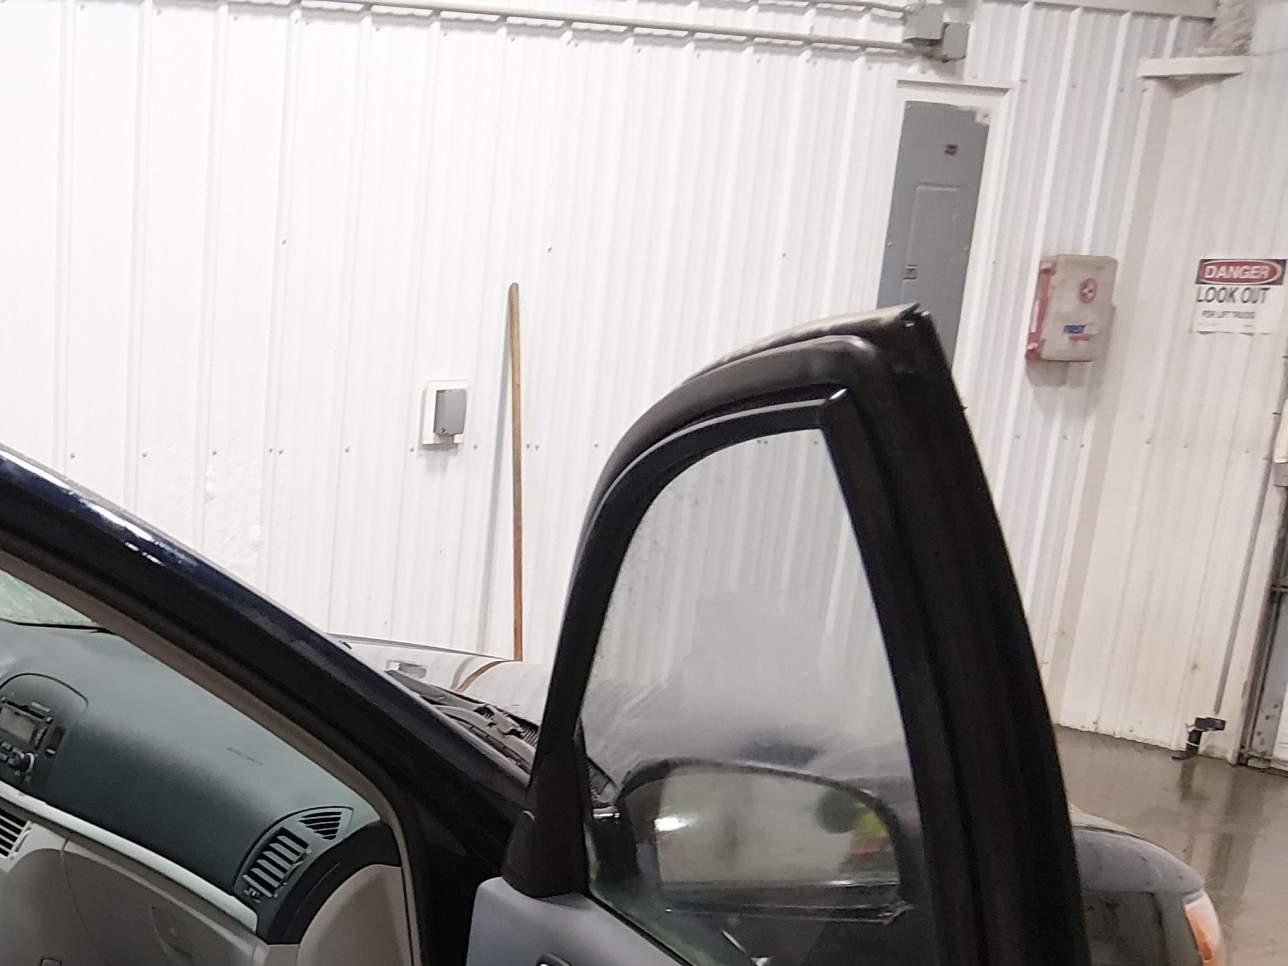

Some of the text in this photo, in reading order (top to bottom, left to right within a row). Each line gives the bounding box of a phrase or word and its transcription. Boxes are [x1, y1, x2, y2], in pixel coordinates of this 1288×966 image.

[1204, 265, 1270, 279] DANGER
[1196, 286, 1271, 304] LOOK OUT
